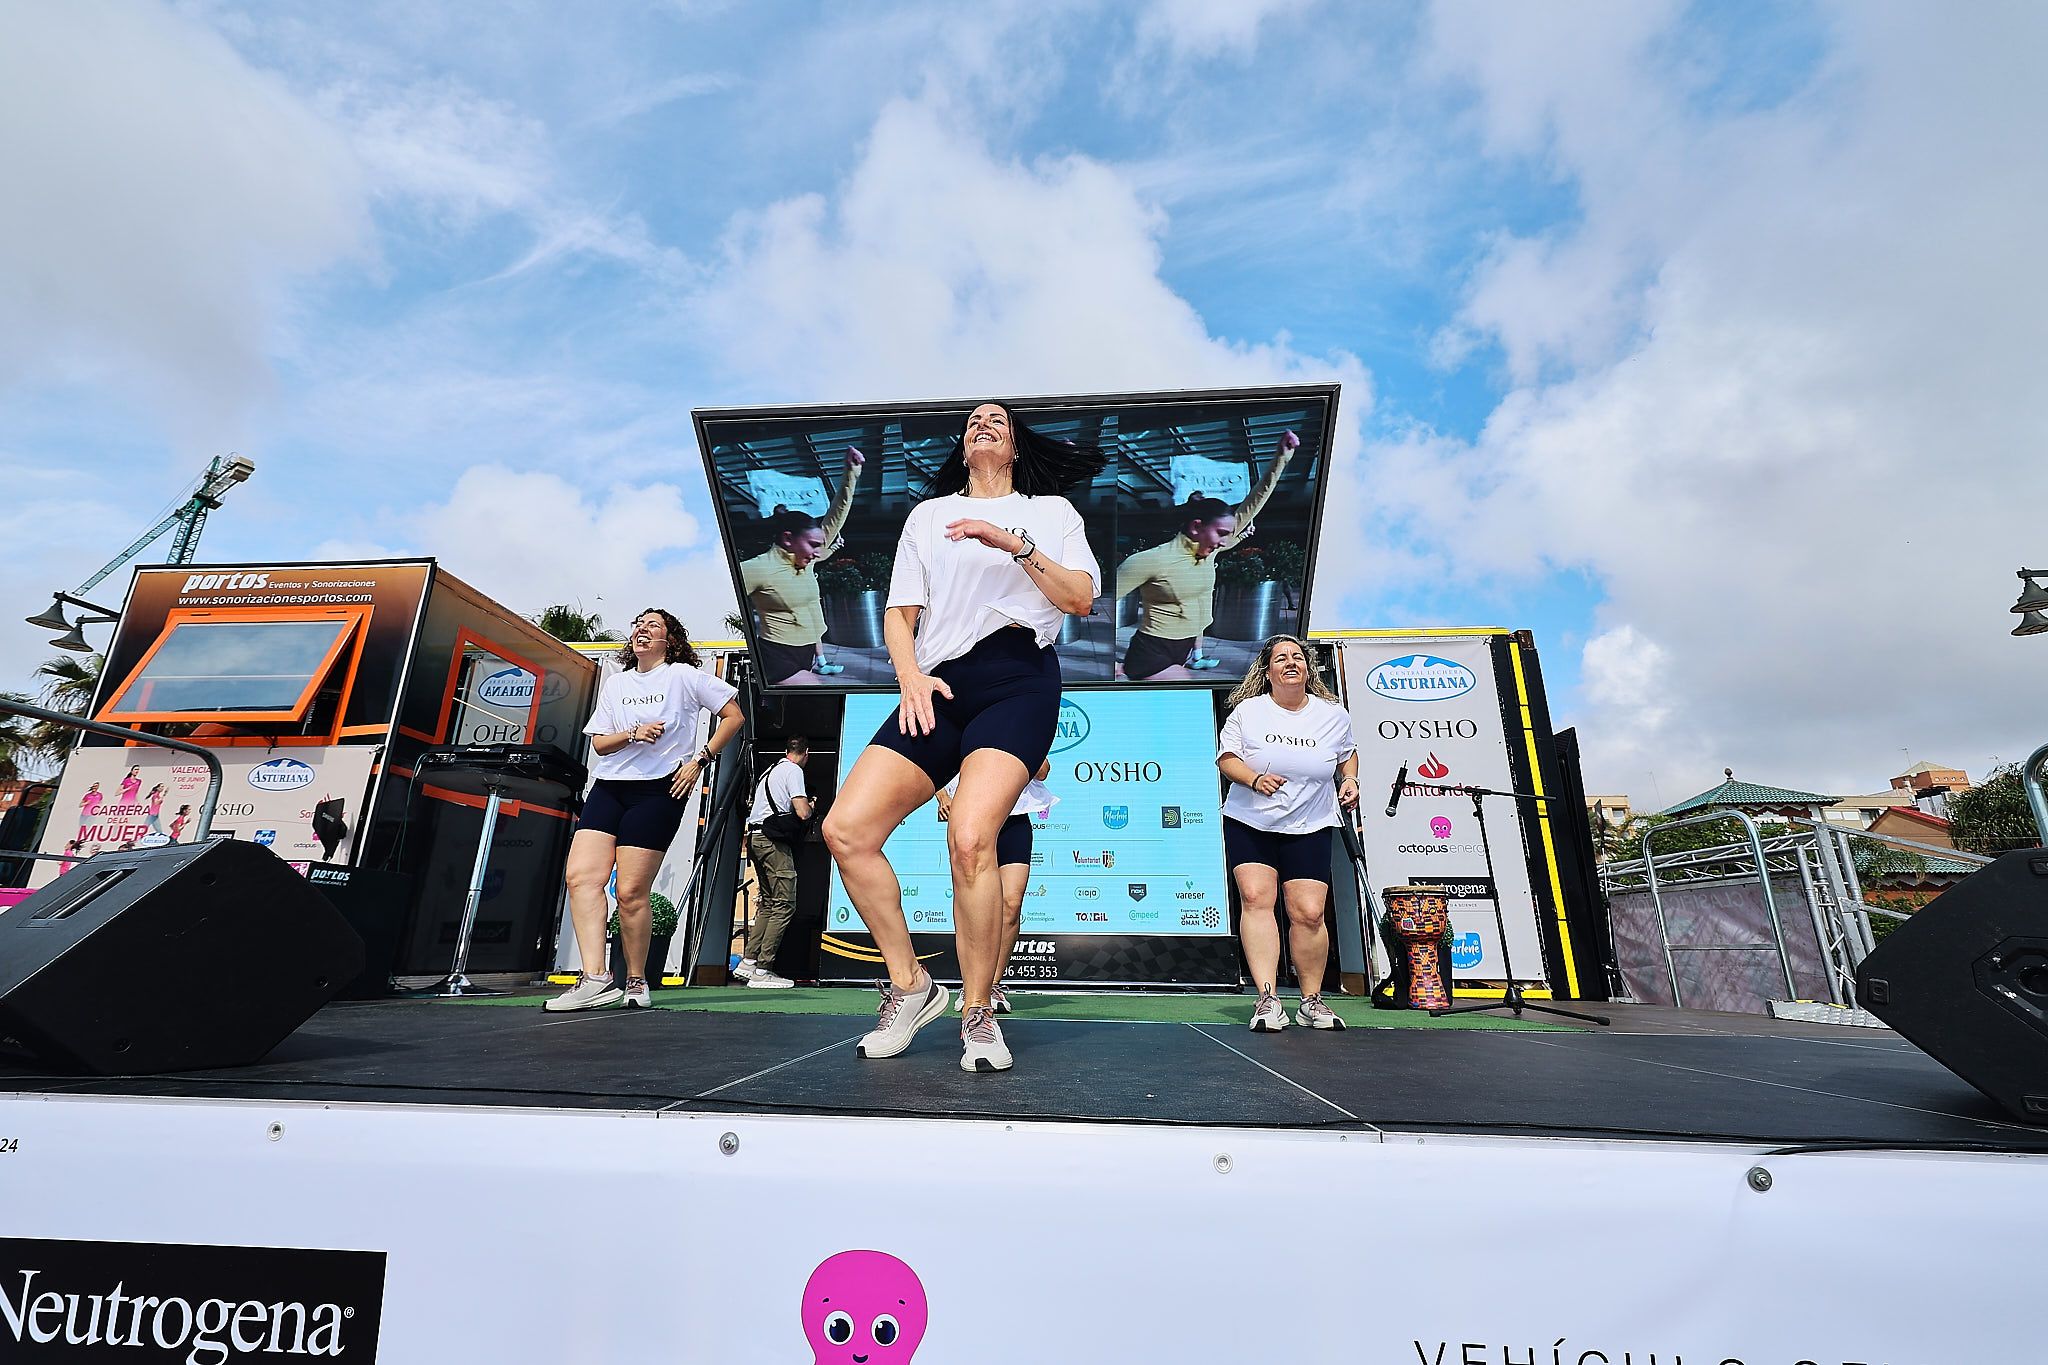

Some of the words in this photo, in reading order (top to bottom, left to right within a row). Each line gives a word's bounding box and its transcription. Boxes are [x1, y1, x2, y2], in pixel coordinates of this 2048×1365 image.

[181, 572, 270, 593] portos
[269, 581, 302, 589] Eventos
[311, 579, 376, 588] Sonorizaciones
[178, 592, 372, 605] www.sonorizacionesportos.com
[1375, 672, 1468, 690] ASTURIANA
[622, 693, 664, 705] OYSHO
[1378, 719, 1477, 739] OYSHO
[1265, 734, 1316, 747] OYSHO
[172, 766, 211, 774] VALENCIA
[252, 770, 309, 782] ASTURIANA
[1075, 761, 1162, 782] OYSHO
[90, 805, 150, 816] CARRERA
[78, 825, 149, 842] MUJER
[1398, 844, 1448, 855] octopus
[1449, 845, 1490, 856] energ
[311, 869, 350, 881] portos
[1175, 892, 1205, 900] vareser
[925, 910, 944, 918] planet
[1129, 910, 1159, 921] Compeed
[1451, 940, 1480, 957] arlene
[1017, 965, 1036, 977] 455
[1039, 966, 1058, 978] 353
